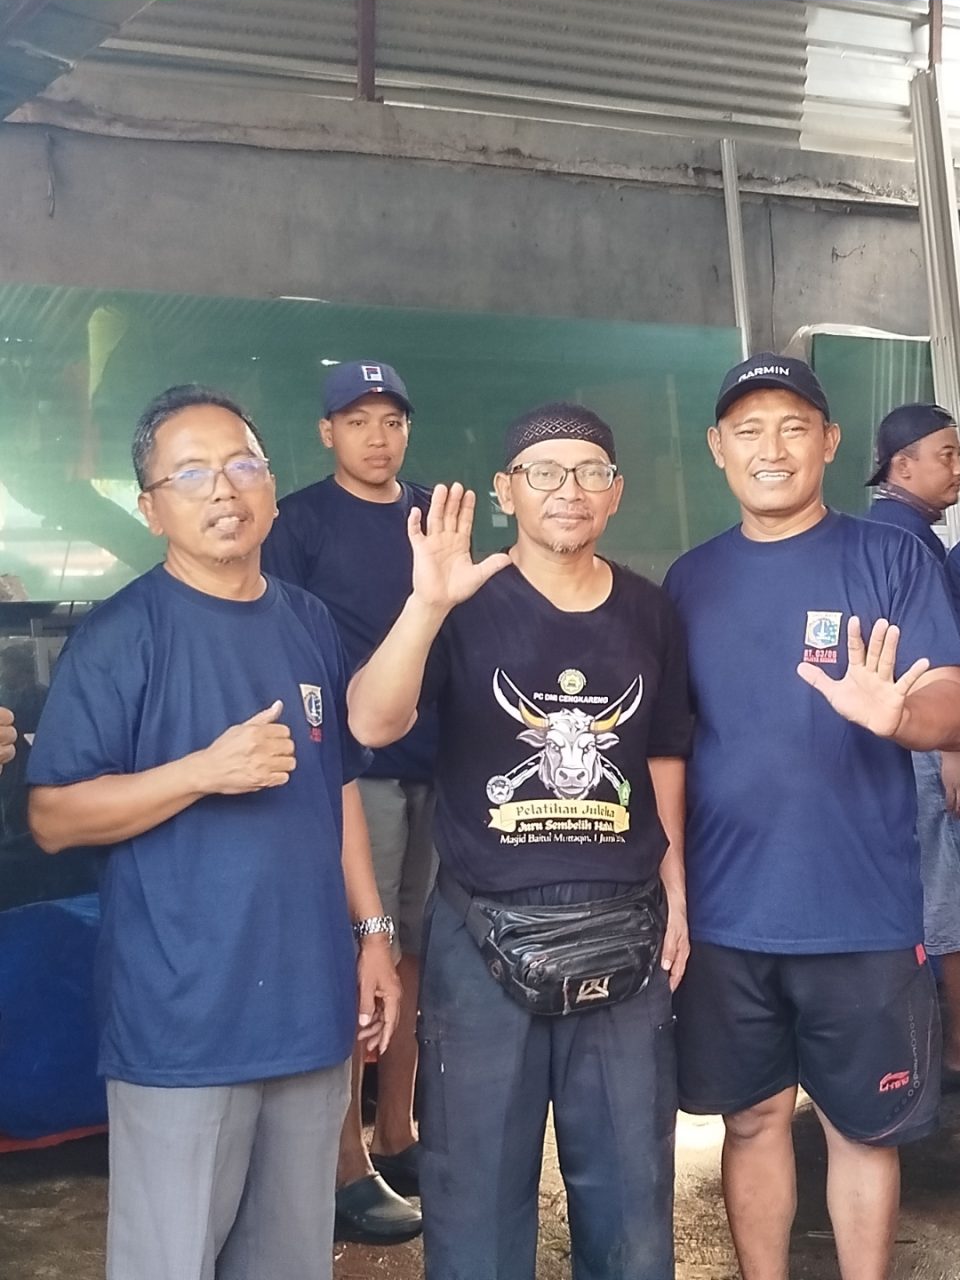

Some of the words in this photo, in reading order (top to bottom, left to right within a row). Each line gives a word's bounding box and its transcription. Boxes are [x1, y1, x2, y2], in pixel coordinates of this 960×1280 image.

[533, 692, 544, 700] PC
[545, 693, 558, 702] DMI
[559, 694, 609, 704] CENGKARENG
[516, 803, 578, 816] Pelatihan
[518, 821, 544, 832] Juru
[545, 820, 592, 831] Sembelih
[500, 834, 527, 847] Masjid
[528, 832, 552, 843] Baitul
